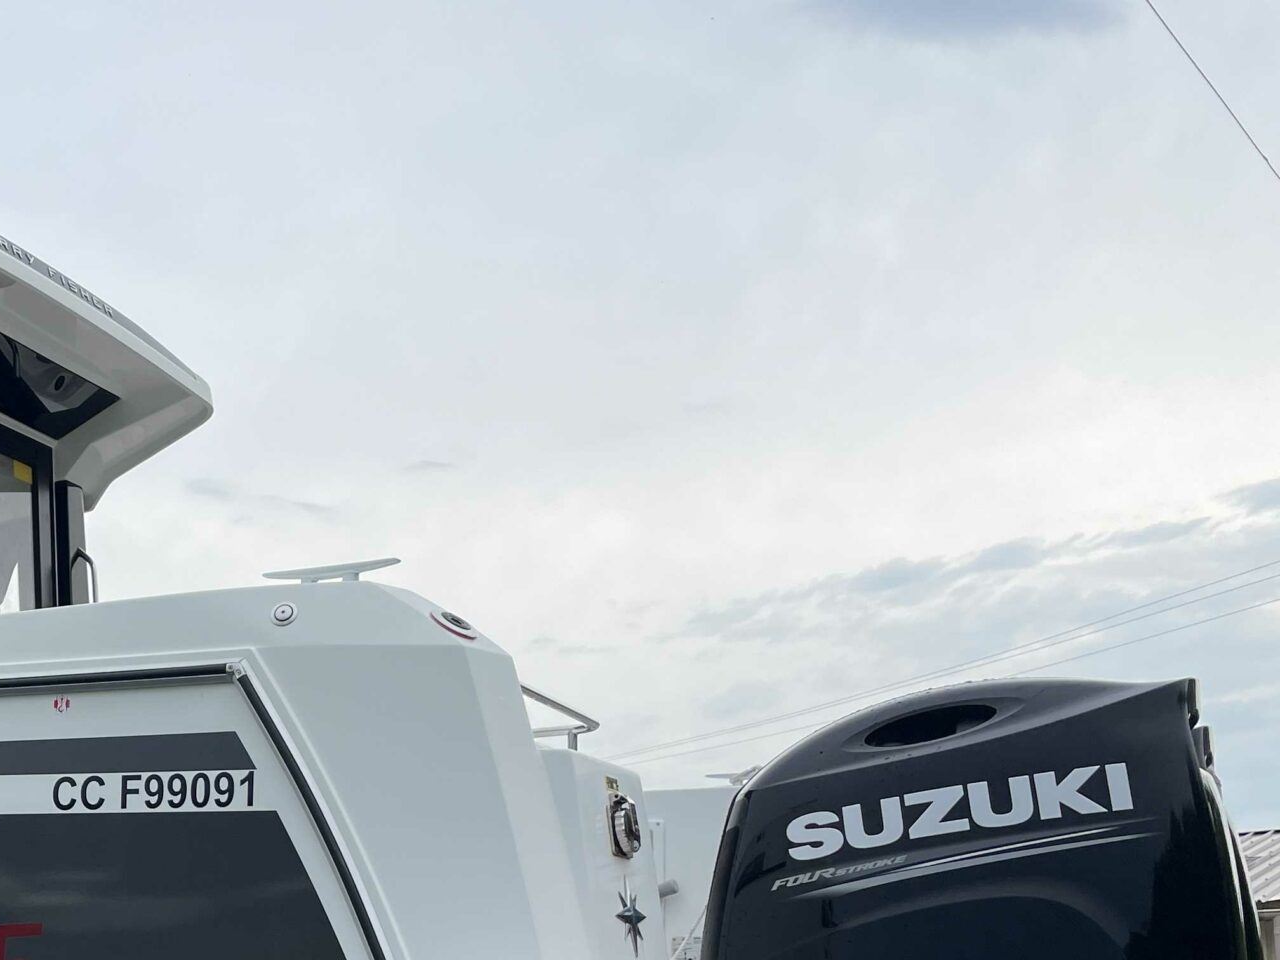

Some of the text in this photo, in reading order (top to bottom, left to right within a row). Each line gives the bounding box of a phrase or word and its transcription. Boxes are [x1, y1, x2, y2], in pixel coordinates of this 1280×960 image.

[47, 267, 114, 317] FISHER
[52, 770, 255, 811] CC F99091
[785, 762, 1134, 861] SUZUKI
